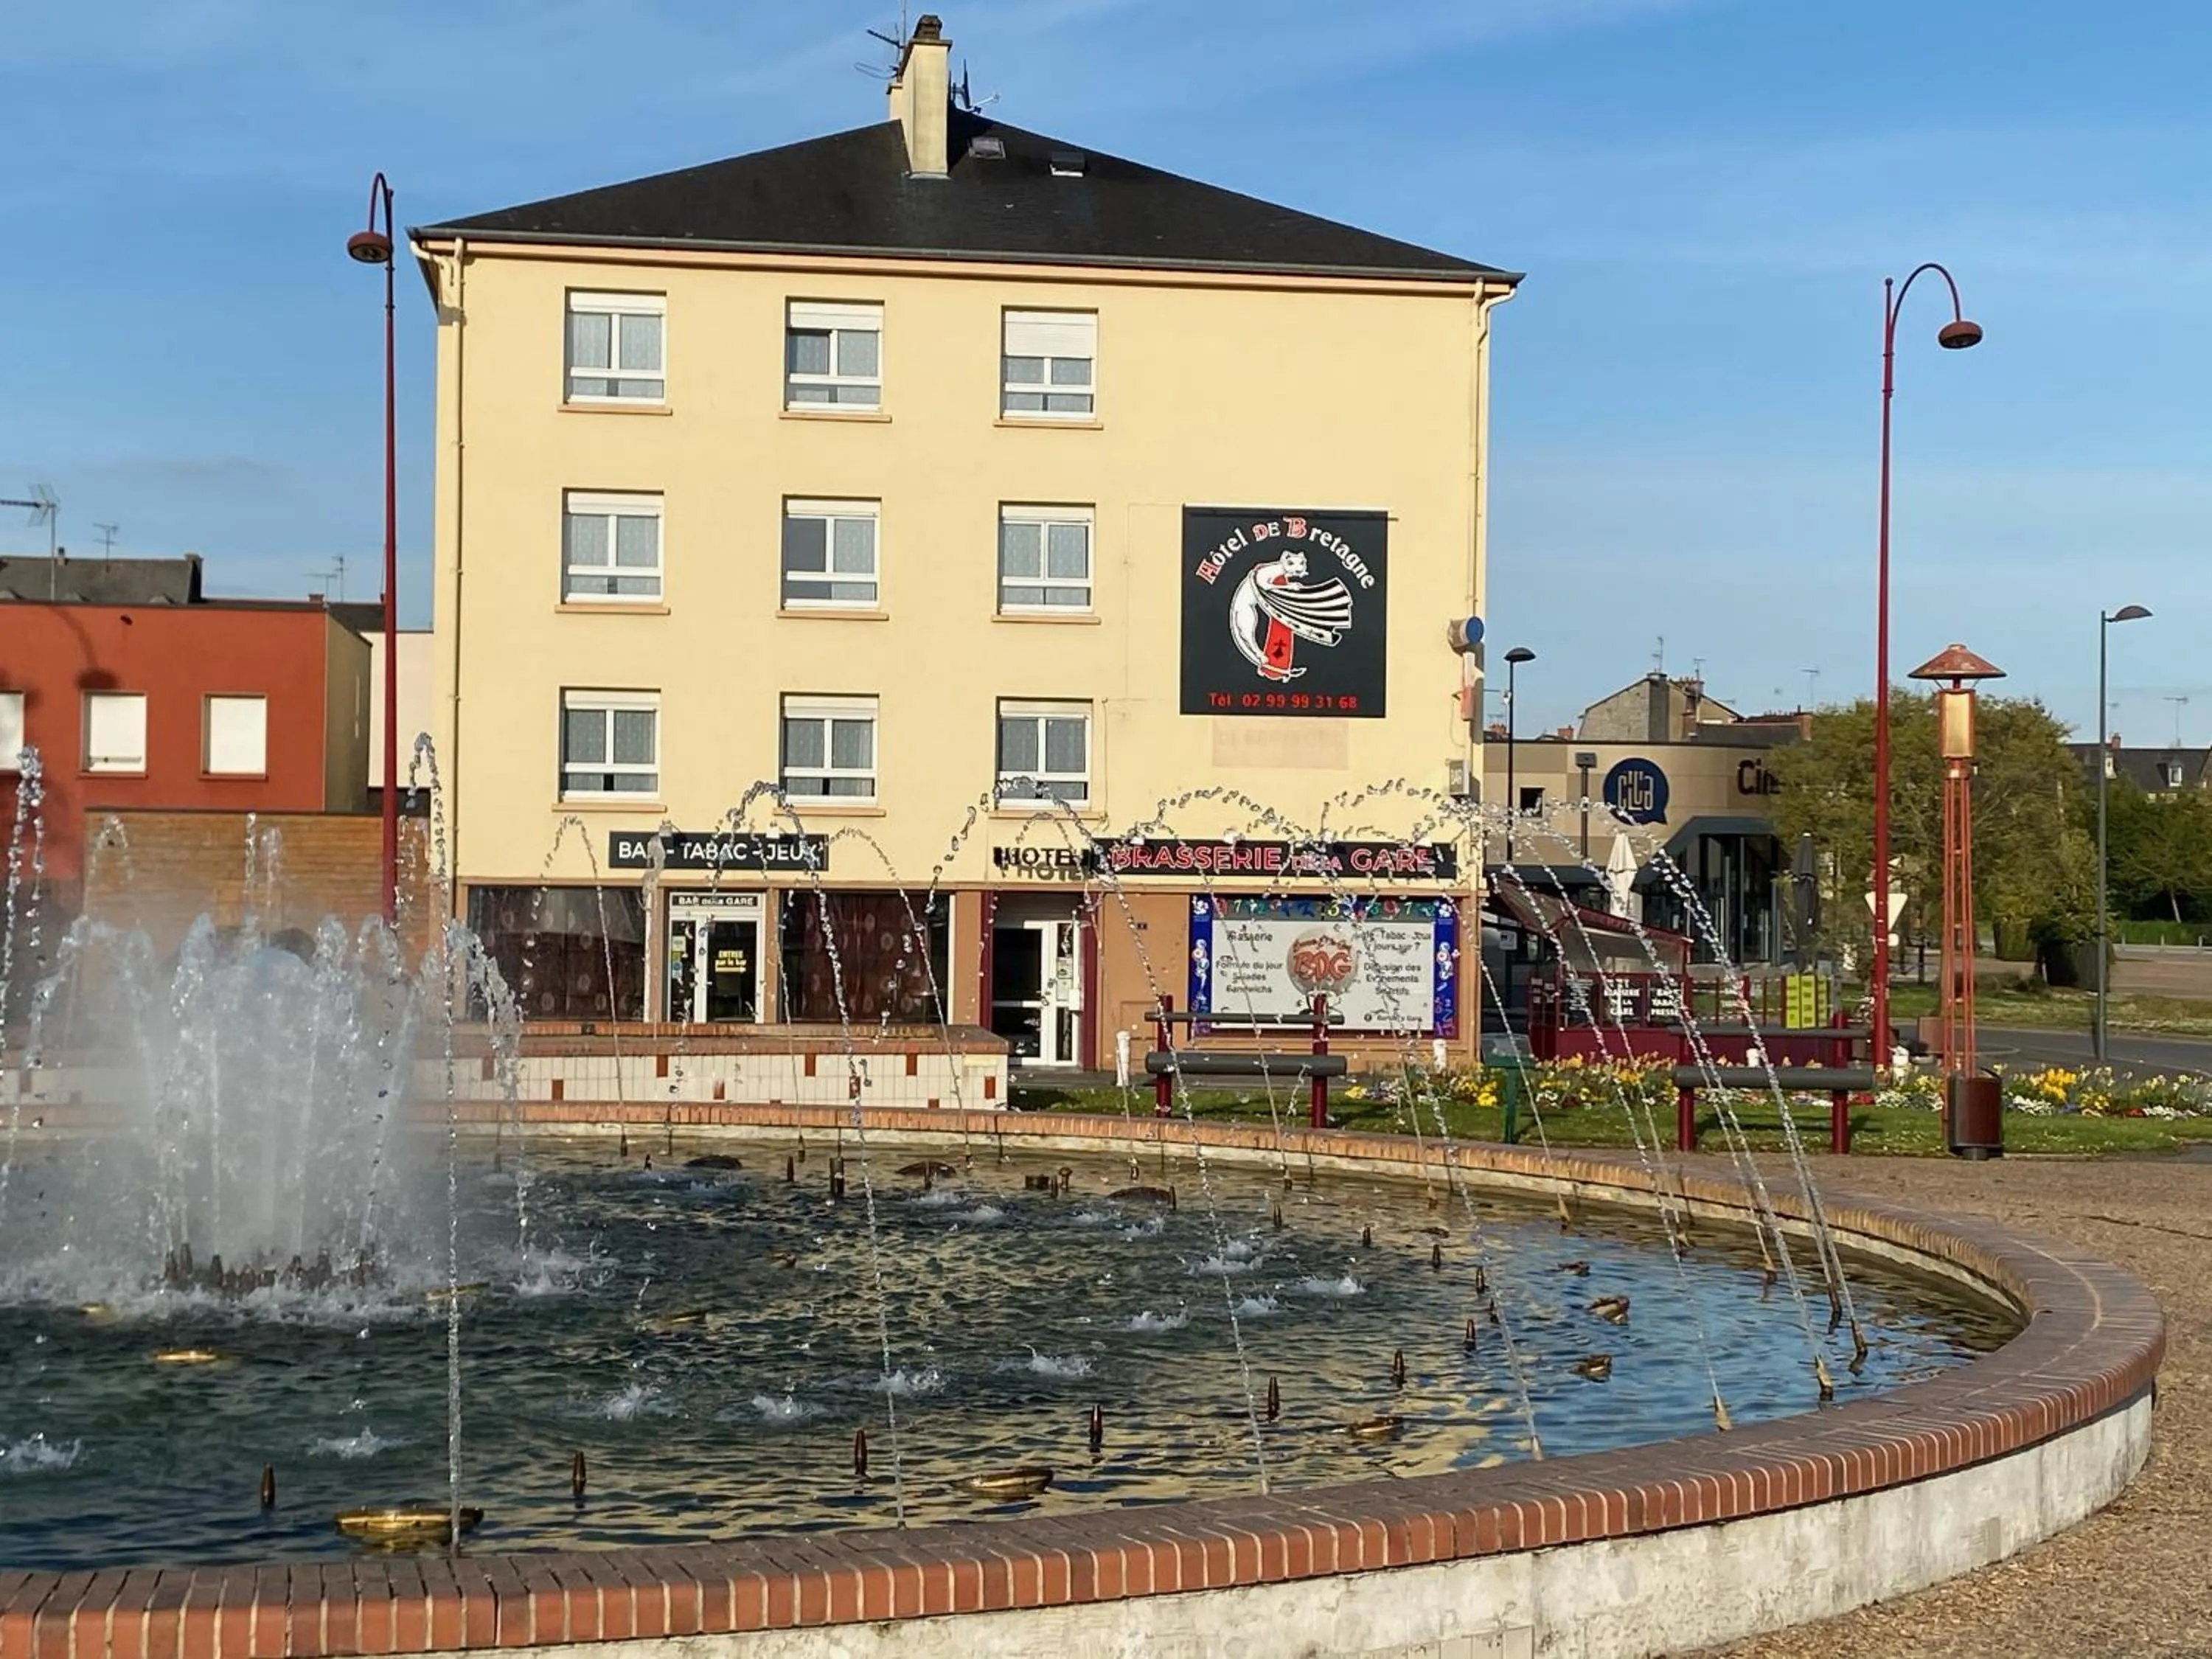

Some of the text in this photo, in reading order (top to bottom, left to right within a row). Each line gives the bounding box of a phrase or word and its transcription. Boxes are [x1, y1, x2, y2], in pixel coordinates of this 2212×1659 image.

[1195, 516, 1375, 589] Hôtel DE Bretagne
[1242, 693, 1260, 708] 02
[1266, 693, 1285, 708] 99
[1291, 693, 1310, 709] 99
[1315, 695, 1332, 709] 31
[1338, 695, 1357, 709] 68
[618, 841, 664, 860] BA
[680, 841, 748, 861] TABAC
[1111, 845, 1283, 871] BRASSERIE
